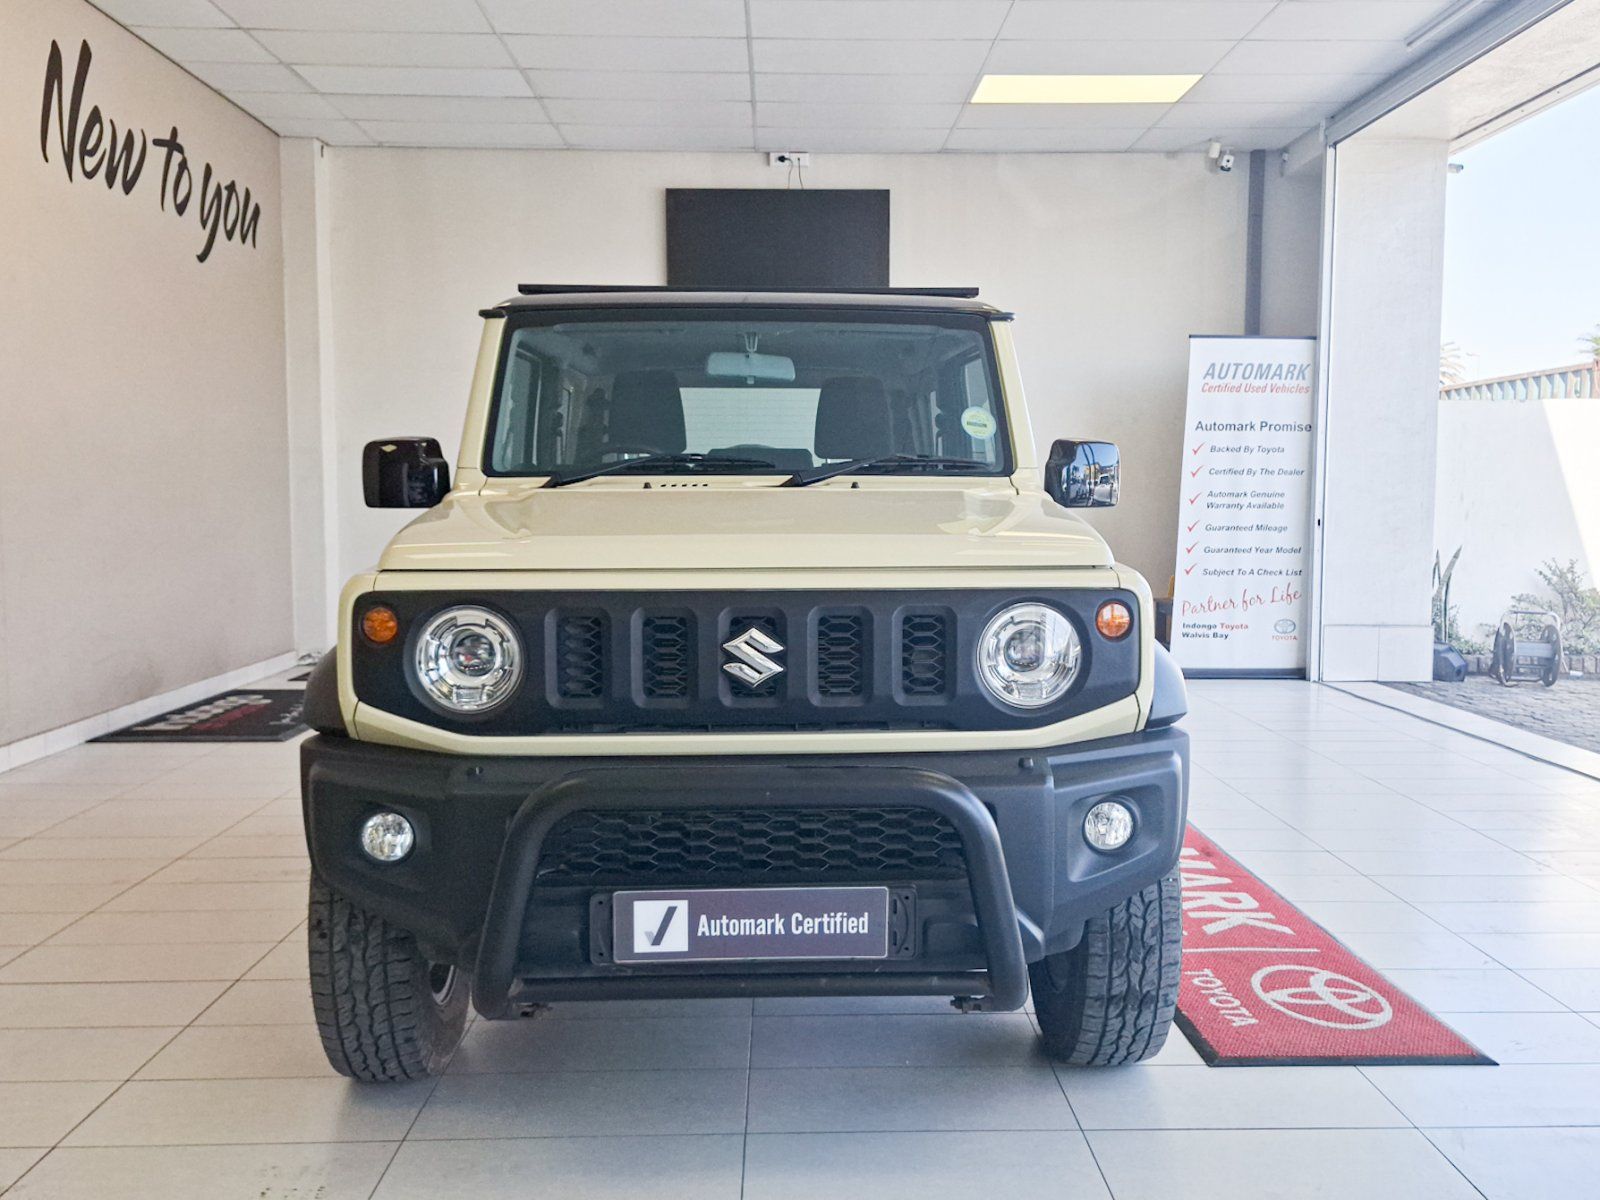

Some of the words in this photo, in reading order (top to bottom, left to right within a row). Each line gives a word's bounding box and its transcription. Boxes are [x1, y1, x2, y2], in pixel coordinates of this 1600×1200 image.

[40, 39, 147, 196] New
[152, 126, 192, 217] to
[196, 162, 260, 263] you
[1203, 362, 1311, 381] AUTOMARK
[1201, 382, 1243, 394] Certified
[1243, 383, 1267, 394] Used
[1269, 383, 1311, 395] Vehicles
[1195, 421, 1256, 433] Automark
[1259, 421, 1312, 433] Promise
[1210, 445, 1241, 454] Backed
[1243, 445, 1254, 456] By
[1257, 445, 1285, 456] Toyota
[1208, 468, 1245, 476] Certified
[1246, 468, 1257, 478] By
[1260, 468, 1276, 477] The
[1277, 468, 1305, 477] Dealer
[1207, 490, 1248, 499] Automark
[1250, 490, 1285, 499] Genuine
[1206, 502, 1244, 511] Warranty
[1246, 502, 1285, 510] Available
[1204, 524, 1253, 532] Guaranteed
[1255, 524, 1288, 534] Mileage
[1203, 546, 1252, 555] Guaranteed
[1254, 546, 1273, 555] Year
[1275, 546, 1302, 555] Model
[1202, 568, 1234, 578] Subject
[1237, 568, 1247, 576] To
[1248, 568, 1255, 576] A
[1257, 568, 1283, 577] Check
[1285, 568, 1303, 577] List
[1182, 595, 1239, 617] Partner
[1241, 588, 1266, 612] for
[1270, 582, 1303, 606] Life
[1220, 622, 1249, 631] Toyota
[1212, 632, 1229, 641] Bay
[697, 913, 785, 937] Automark
[790, 911, 870, 935] Certified
[1183, 968, 1259, 1028] TOYOTA
